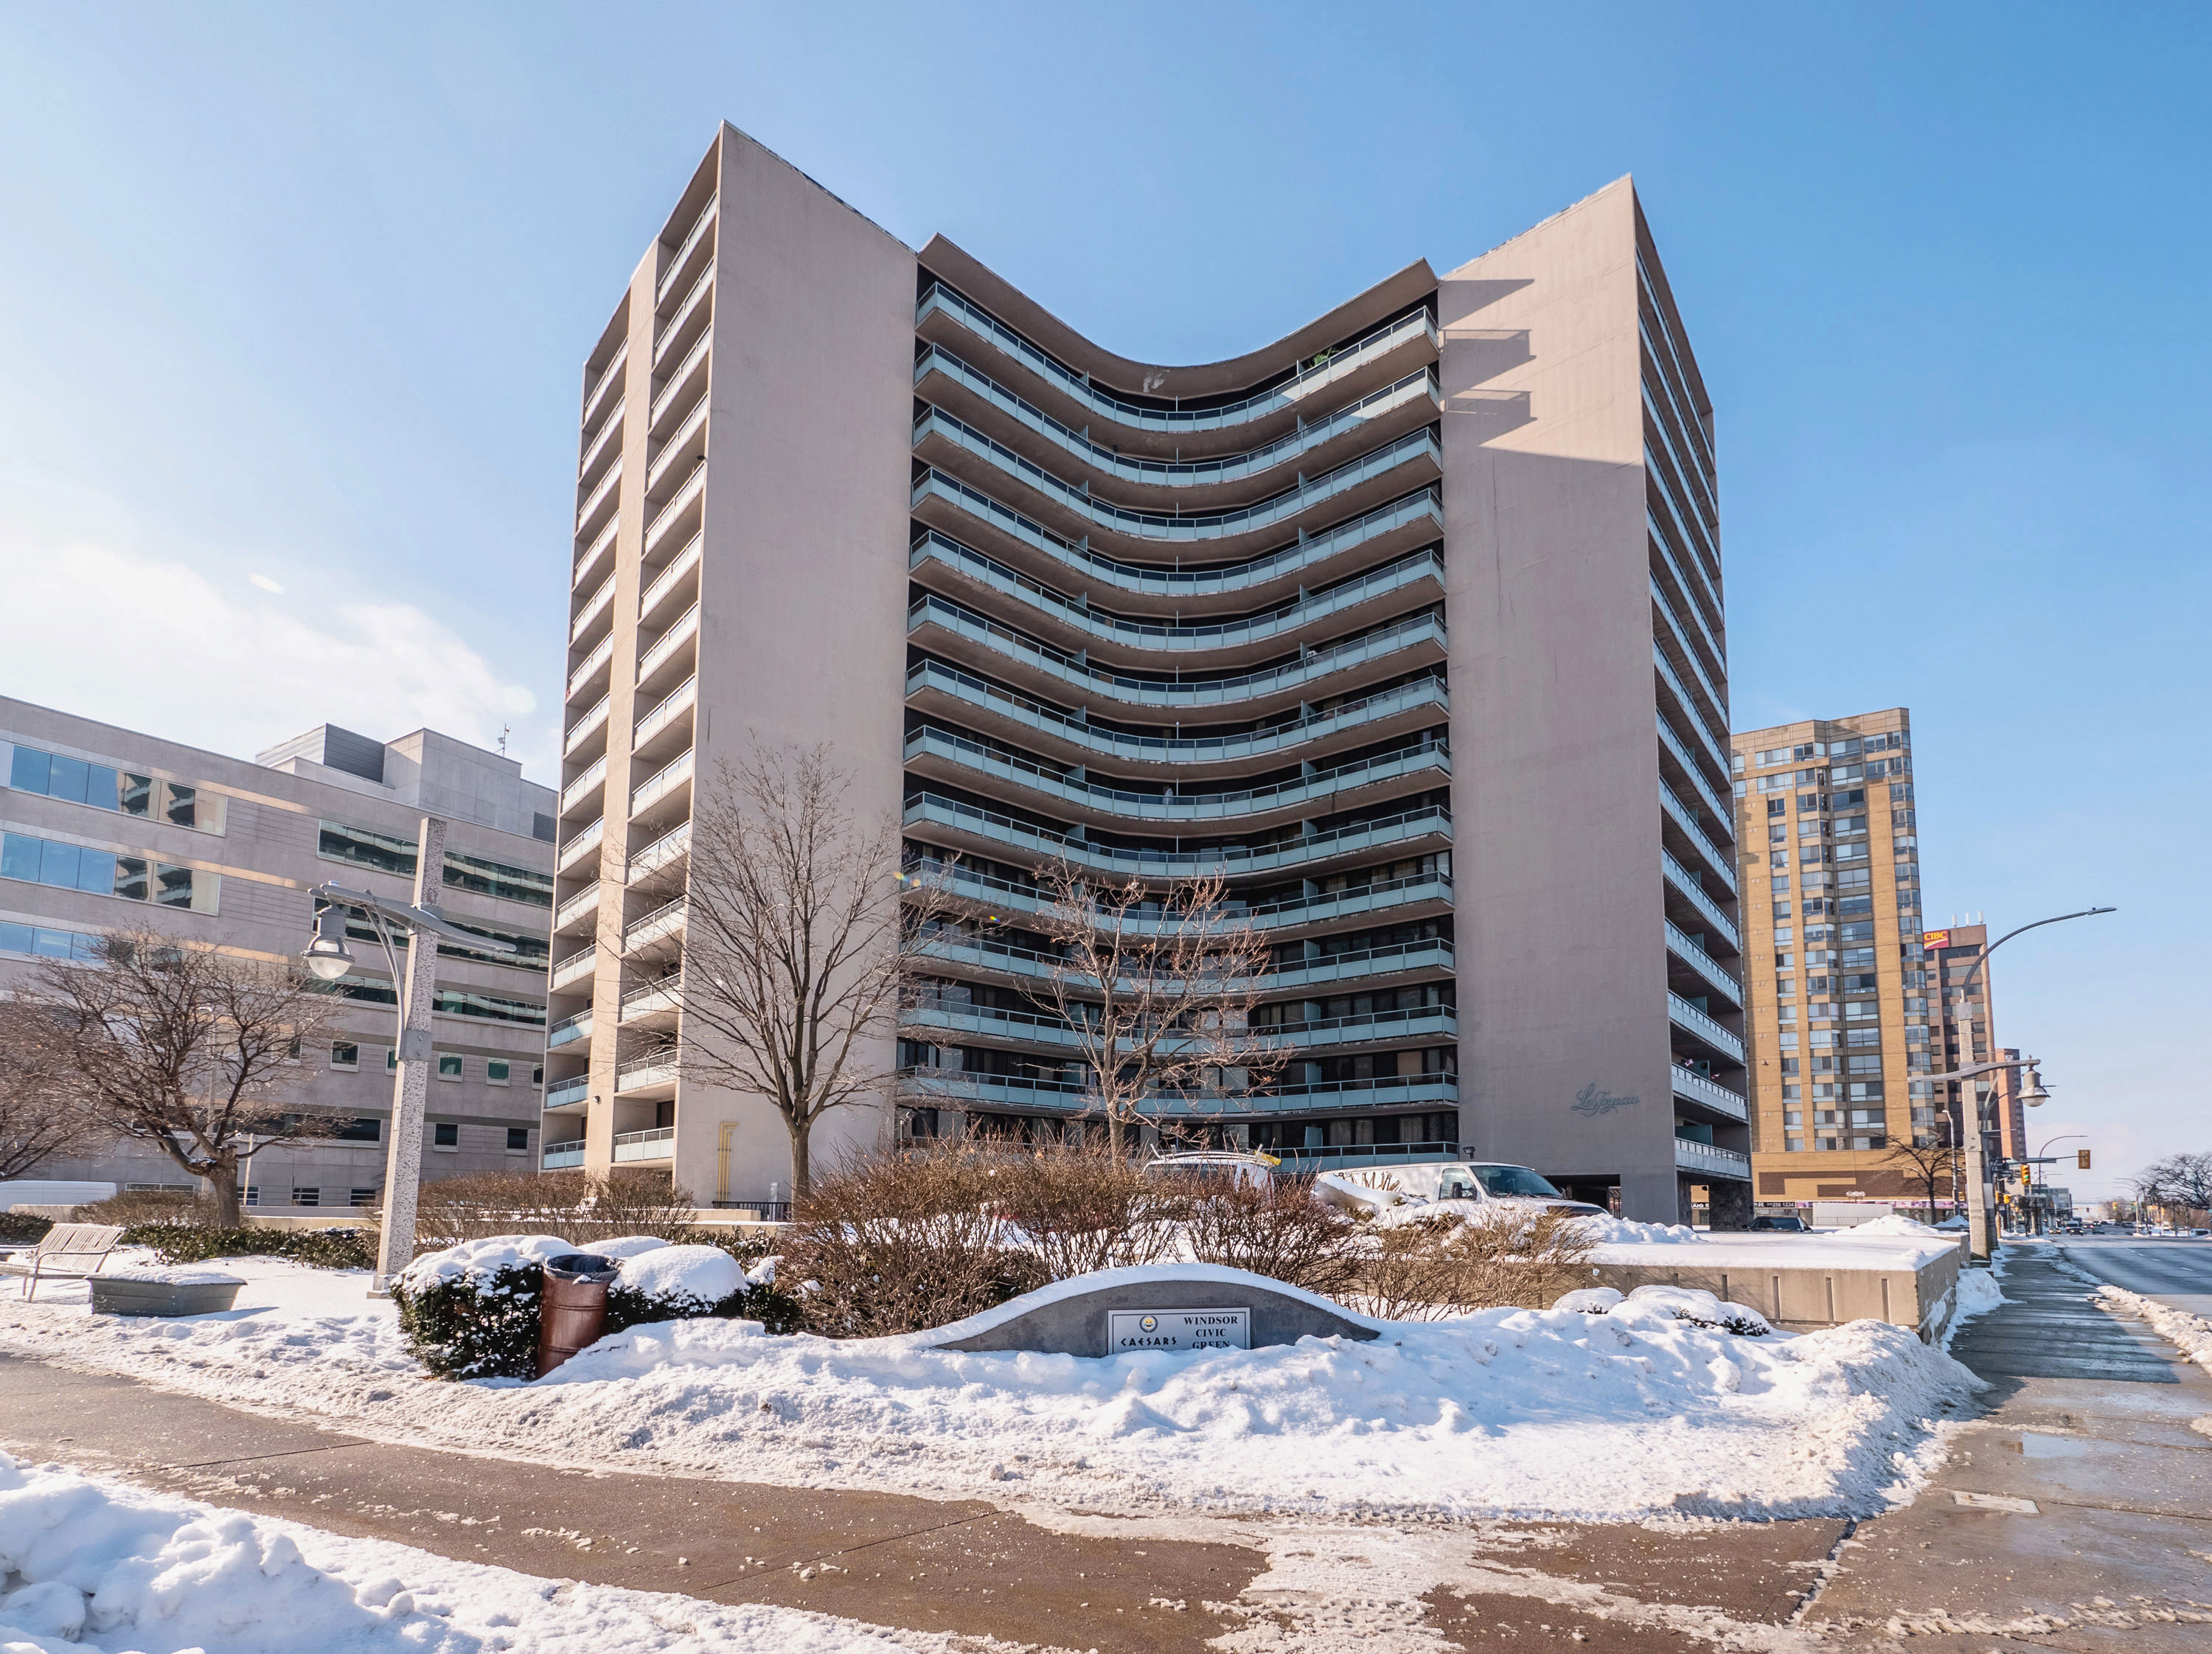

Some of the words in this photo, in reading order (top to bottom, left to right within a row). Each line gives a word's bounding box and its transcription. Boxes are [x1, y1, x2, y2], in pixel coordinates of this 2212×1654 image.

[1924, 931, 1947, 941] CIBC
[1183, 1316, 1238, 1325] WINDSOR
[1195, 1328, 1227, 1338] CIVIC
[1120, 1335, 1177, 1347] CAESARS
